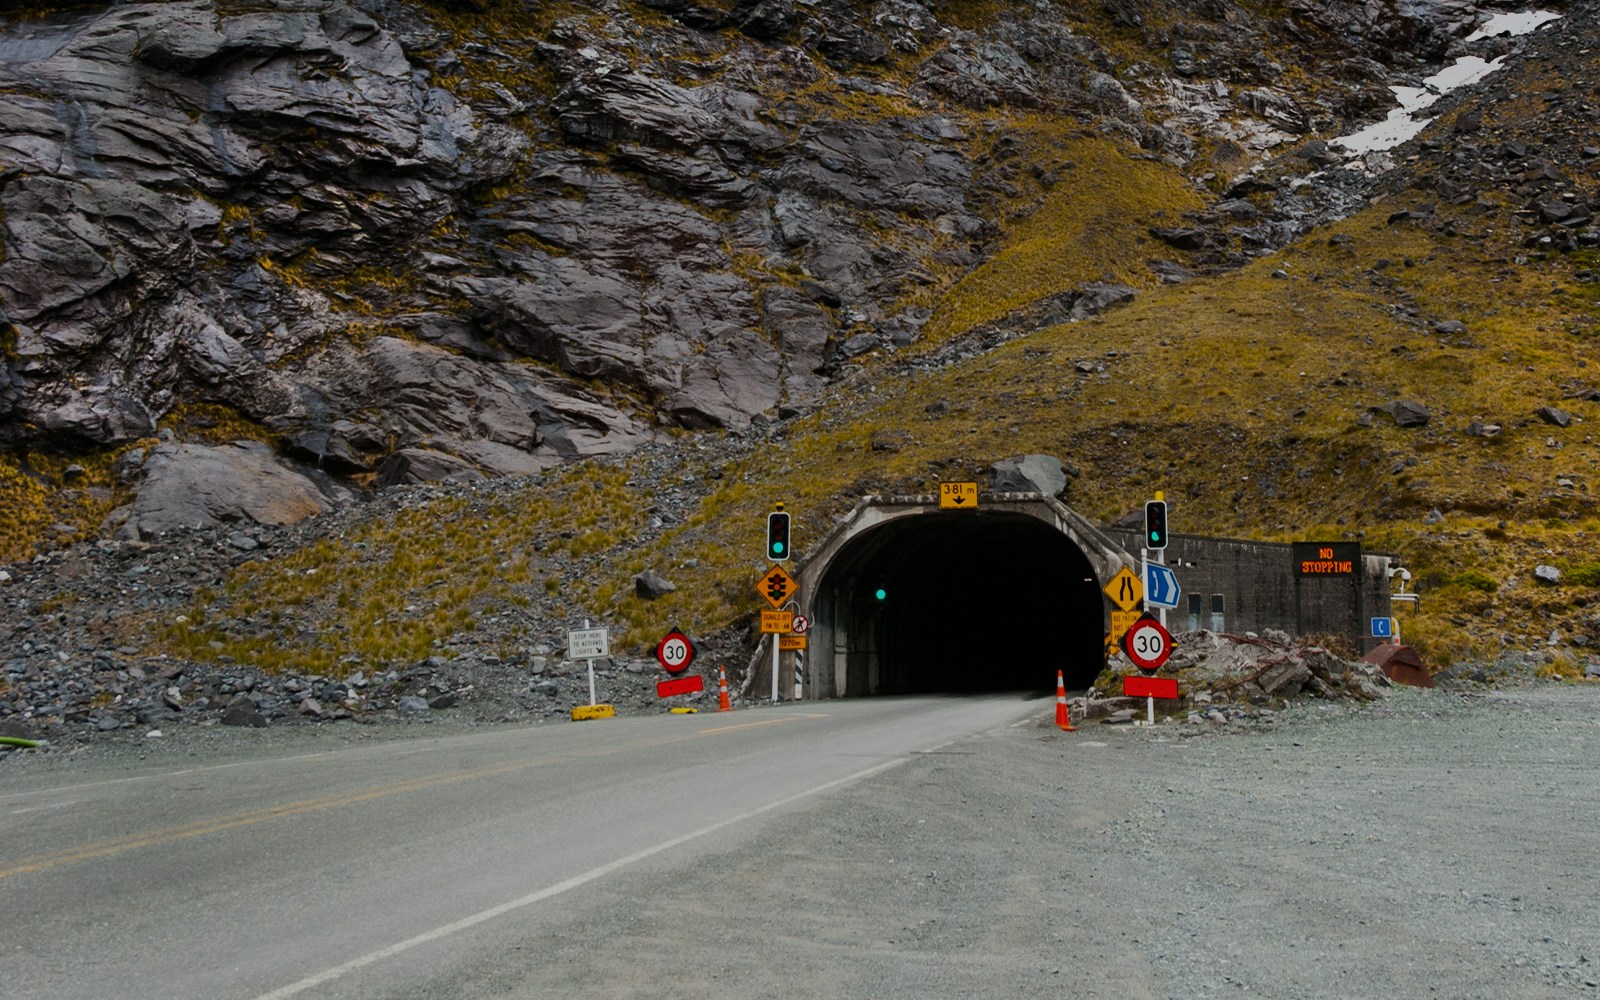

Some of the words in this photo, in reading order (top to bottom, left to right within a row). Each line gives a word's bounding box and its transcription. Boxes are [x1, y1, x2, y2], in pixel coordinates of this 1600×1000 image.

[1319, 547, 1334, 560] NO
[1302, 560, 1352, 573] STOPPING
[781, 639, 800, 647] 1270m
[1137, 635, 1160, 653] 30
[666, 646, 684, 660] 30
